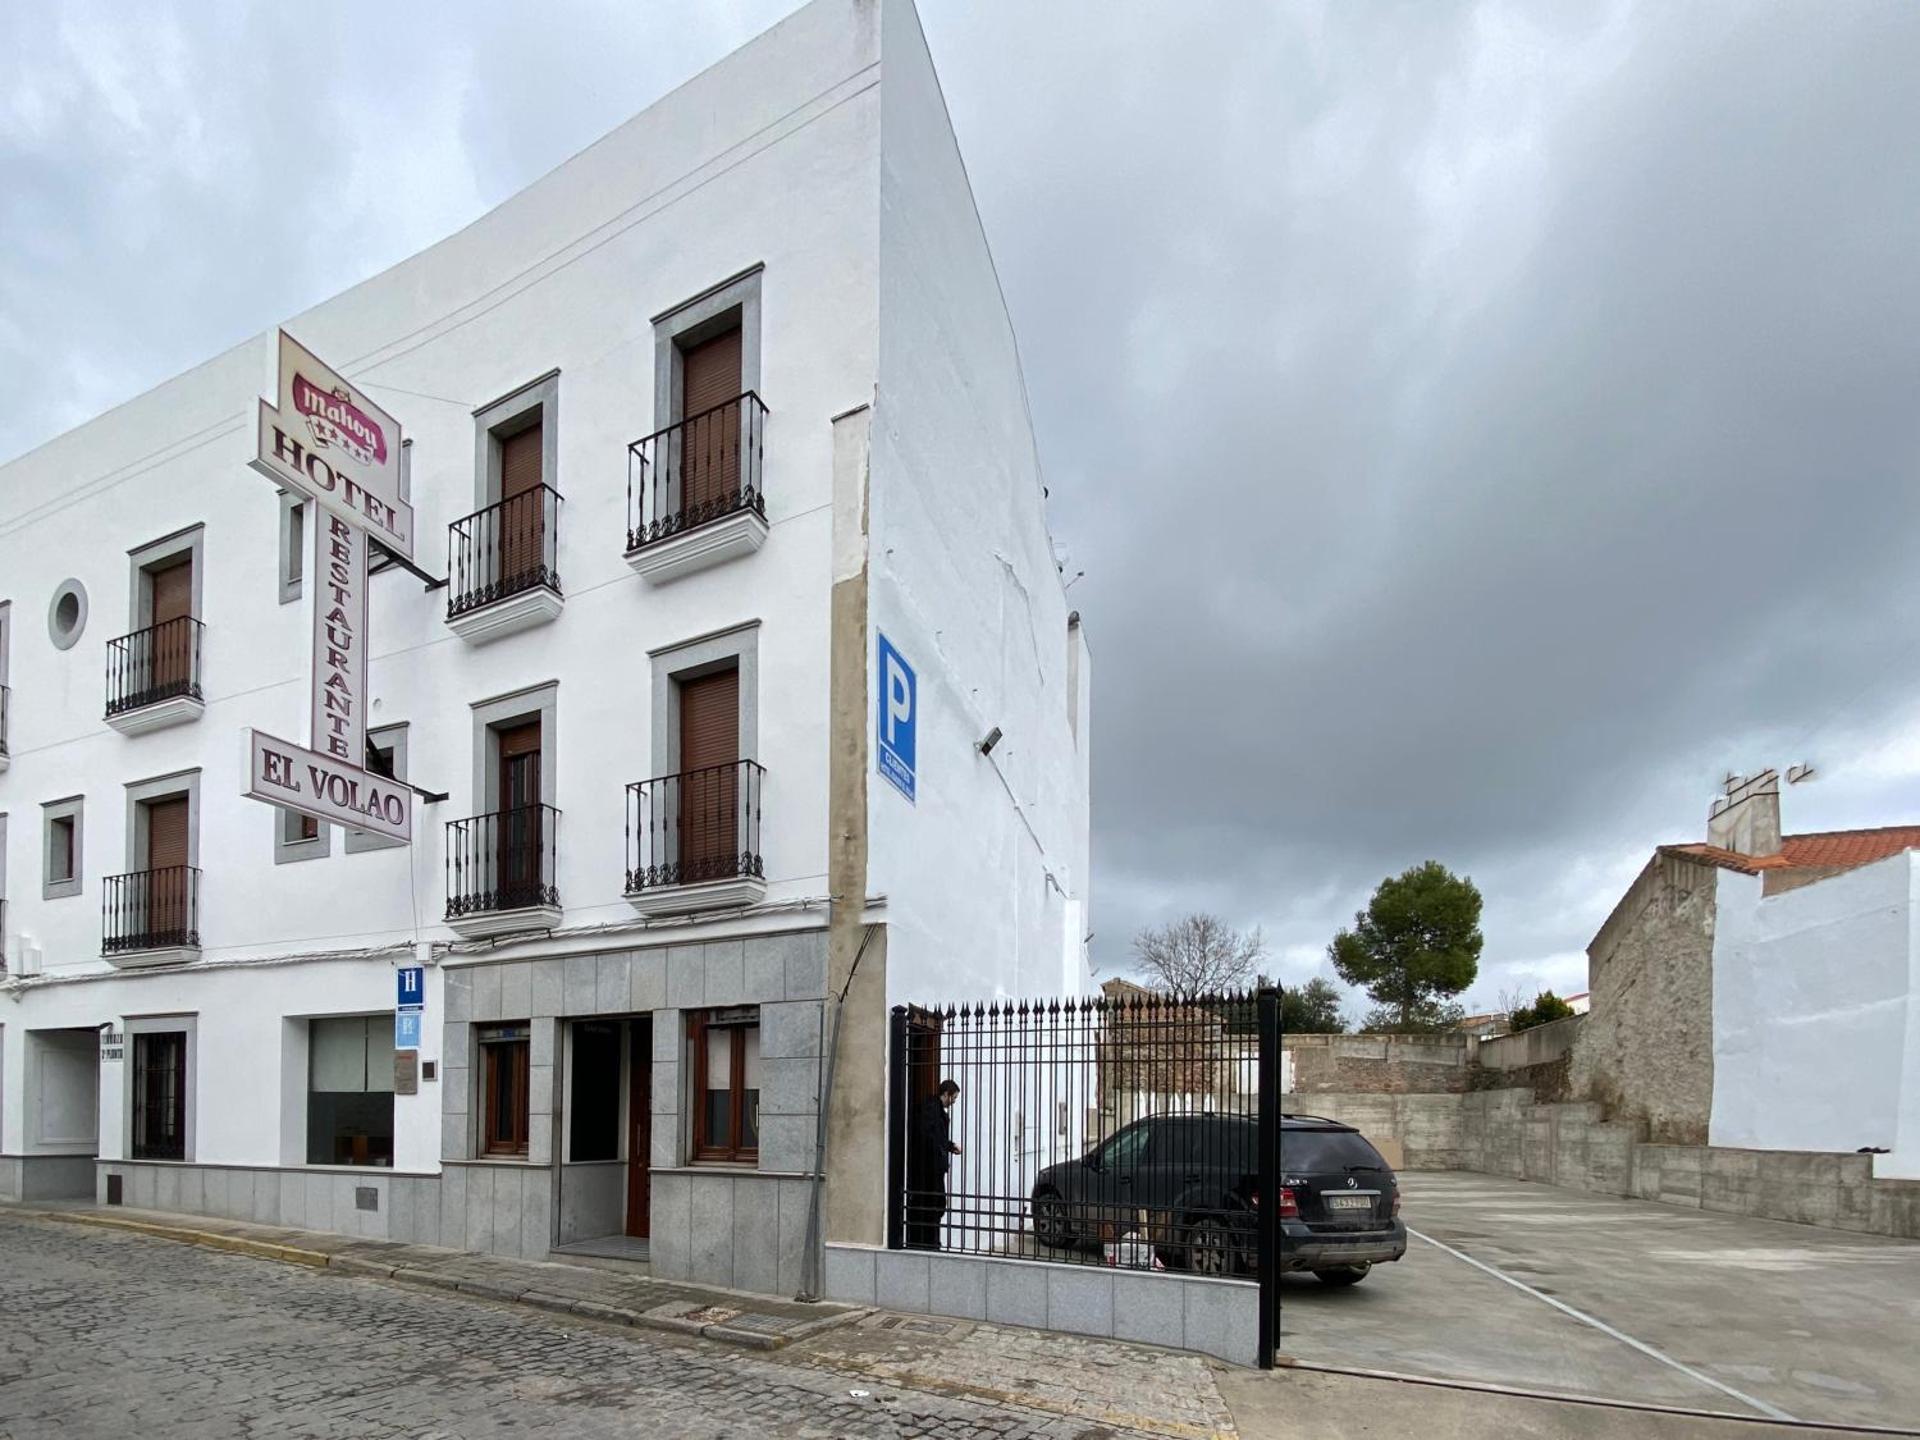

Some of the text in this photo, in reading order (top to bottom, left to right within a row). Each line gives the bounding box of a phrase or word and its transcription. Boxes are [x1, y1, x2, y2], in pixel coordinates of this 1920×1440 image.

[272, 425, 406, 542] HOTEL
[325, 514, 353, 760] RESTAURANTE
[887, 652, 911, 745] P
[262, 748, 404, 826] EL VOLAO
[405, 970, 416, 992] H
